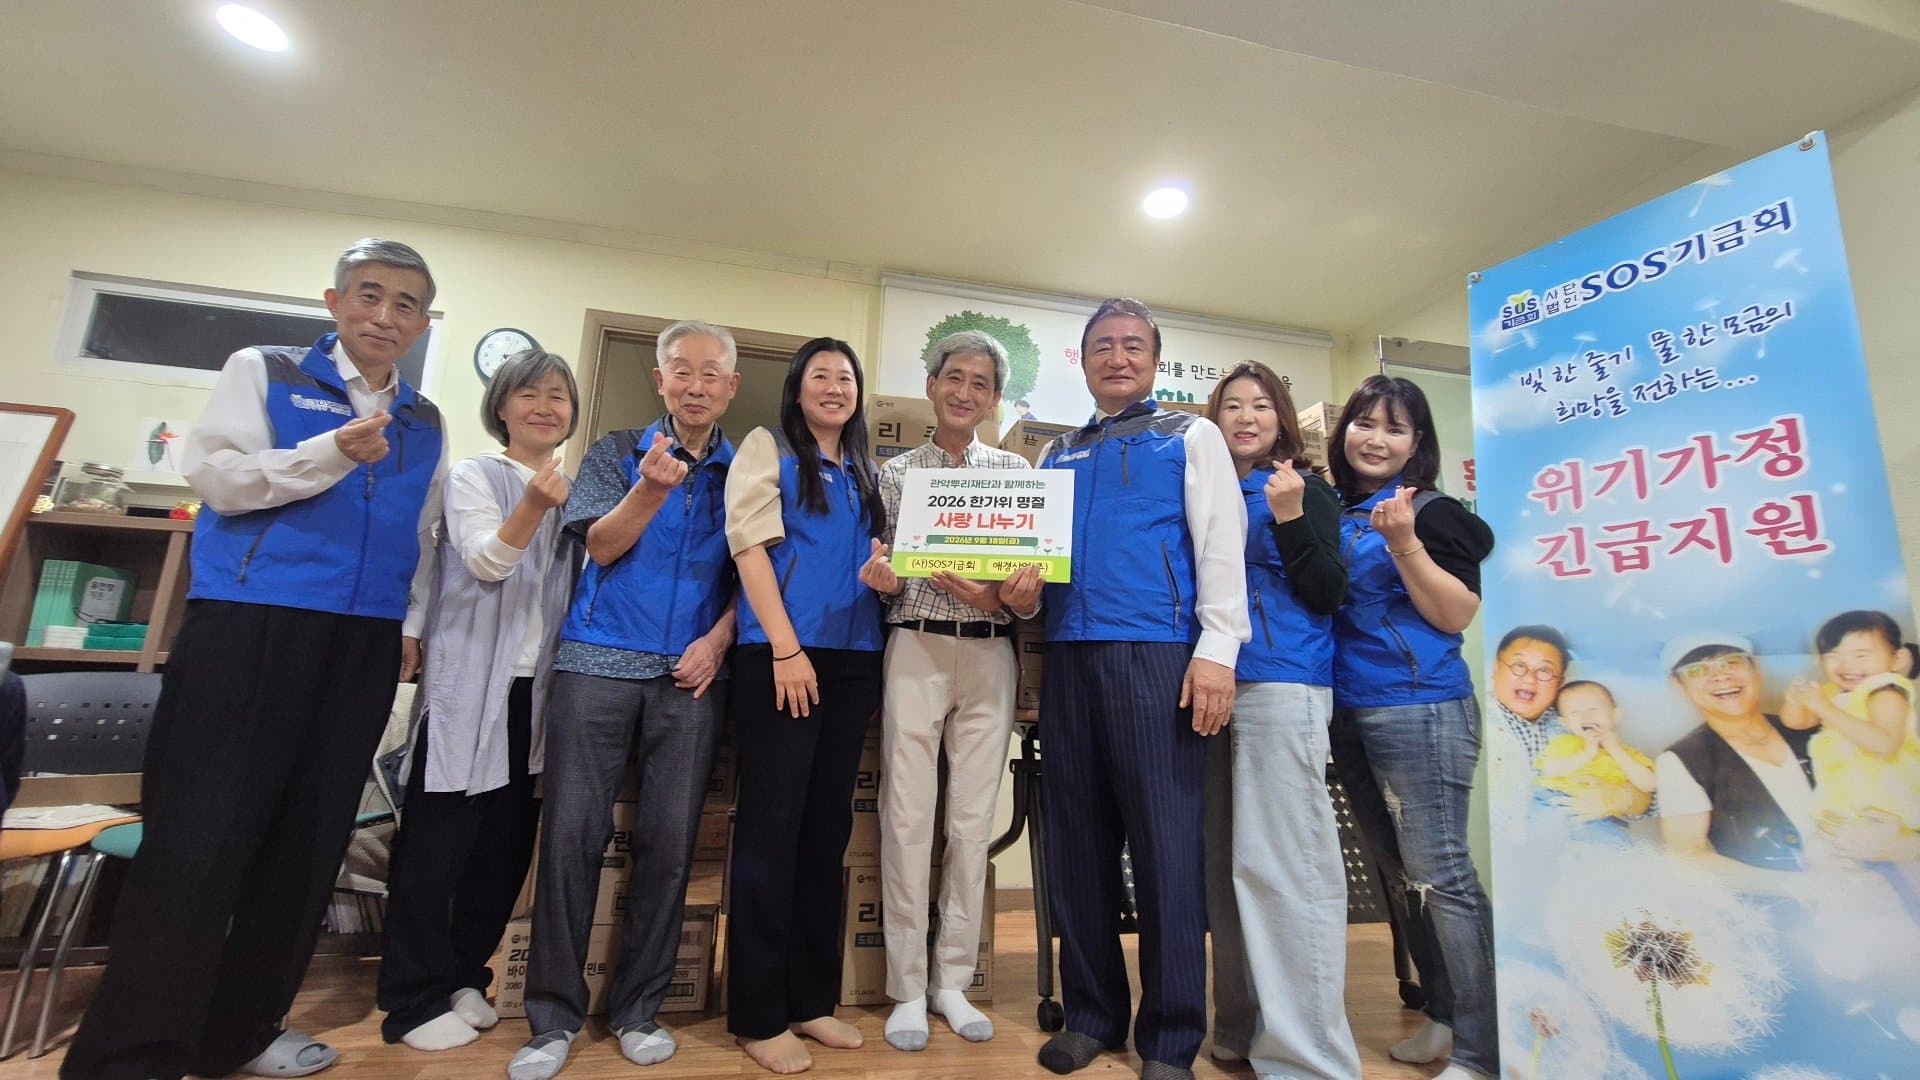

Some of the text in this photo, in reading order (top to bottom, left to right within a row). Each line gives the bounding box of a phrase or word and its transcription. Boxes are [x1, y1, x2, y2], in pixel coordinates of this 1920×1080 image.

[1581, 201, 1792, 301] SOS기금회
[1545, 282, 1577, 301] 사단
[1546, 296, 1578, 314] 법인
[1521, 302, 1791, 393] 빛 한 줄기 물 한 모금의
[1556, 386, 1627, 422] 희망을
[1531, 417, 1804, 512] 위기가정
[930, 479, 1046, 489] 관악뿌리재단과 함께하는
[928, 495, 1045, 509] 2026 한가위 명절
[934, 512, 1035, 530] 사랑 나누기
[944, 536, 973, 544] 2026년
[1536, 495, 1827, 576] 긴급지원
[911, 559, 976, 571] (사)SOS기금회
